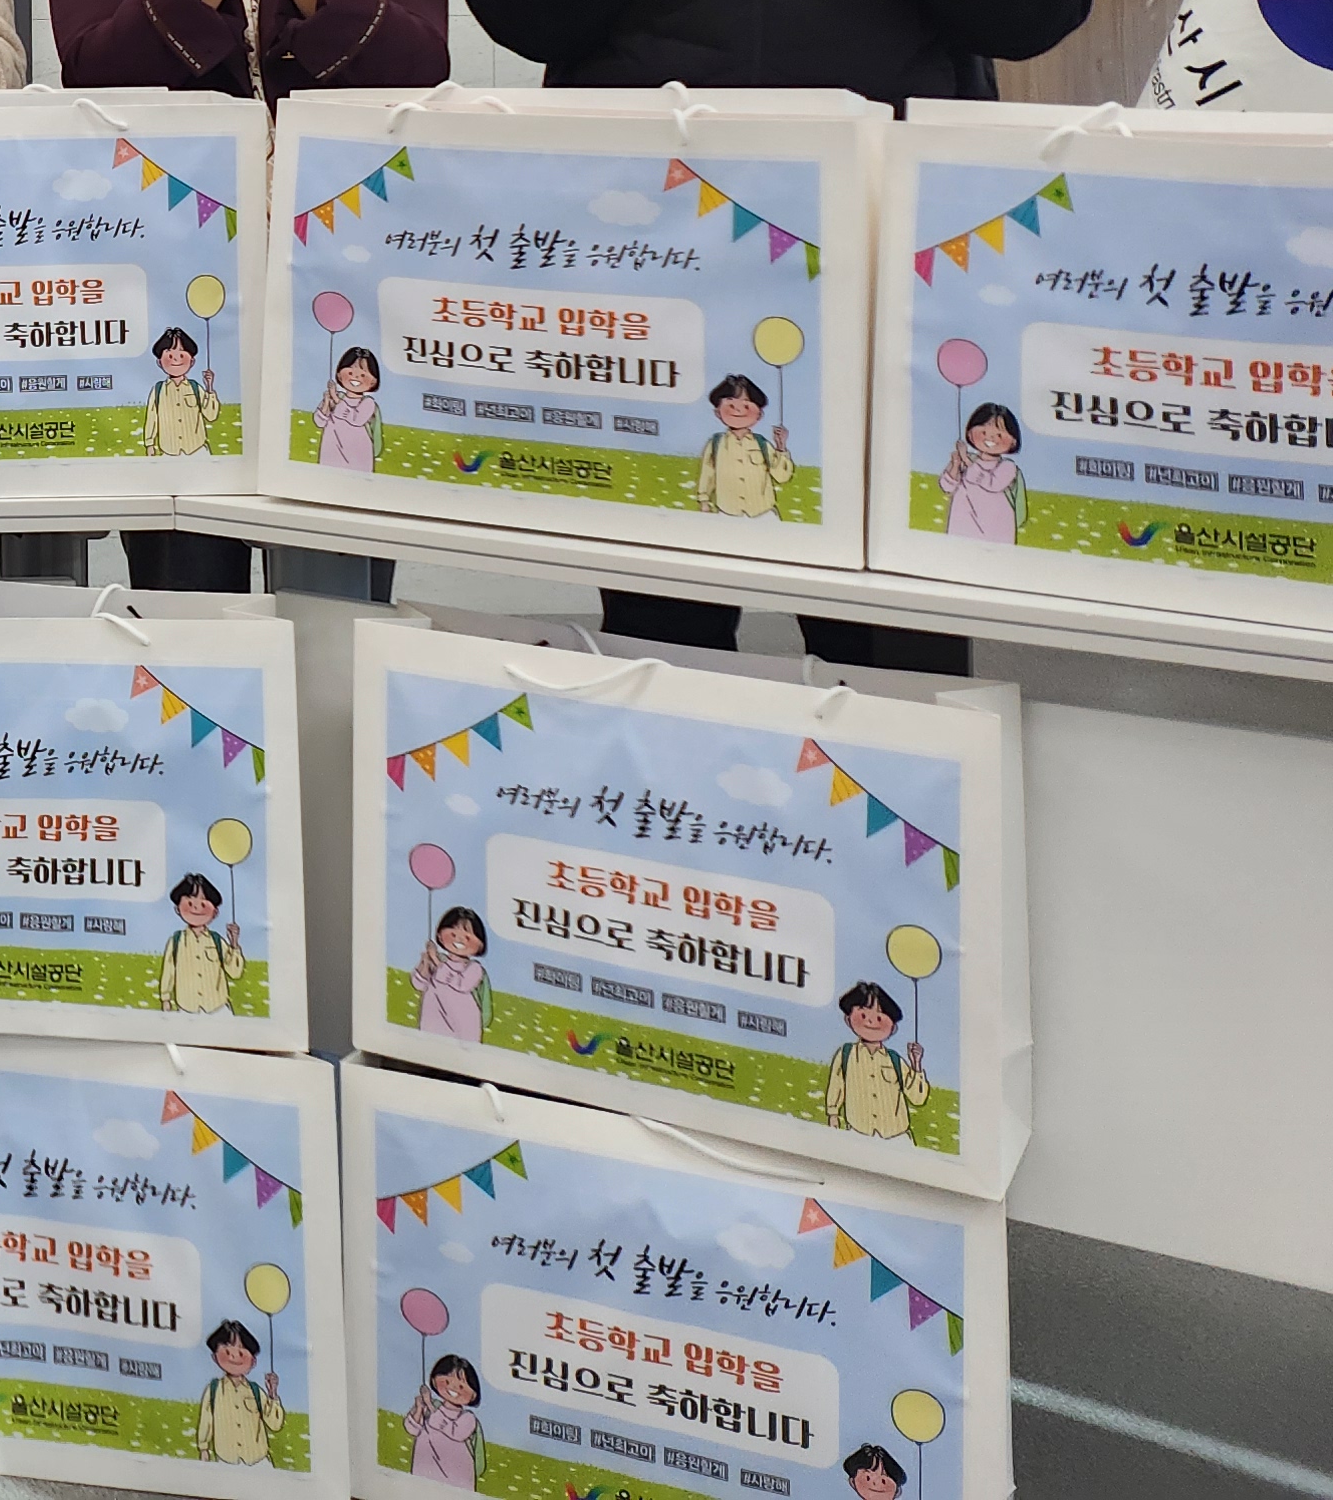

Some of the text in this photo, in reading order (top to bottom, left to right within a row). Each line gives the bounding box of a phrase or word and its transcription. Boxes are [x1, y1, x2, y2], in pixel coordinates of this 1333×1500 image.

[32, 279, 105, 306] 입학을
[4, 319, 130, 348] 축하합니다
[433, 297, 651, 341] 초등학교 입학을
[402, 335, 681, 388] 진심으로 축하합니다
[1090, 347, 1237, 388] 초등학교
[1050, 390, 1333, 456] 진심으로 축하합
[39, 814, 119, 842] 입학을
[6, 857, 145, 886] 축하합니다
[547, 861, 779, 932] 초등학교 입학을
[512, 898, 810, 988] 진심으로 축하합니다
[68, 1241, 153, 1279] 입학을
[491, 1234, 578, 1271] 여러분의
[587, 1239, 621, 1282] 첫
[632, 1245, 709, 1302] 출발을
[37, 1284, 181, 1330] 축하합니다
[545, 1312, 783, 1392] 초등학교 입학을
[508, 1348, 814, 1449] 진심으로 축하합니다
